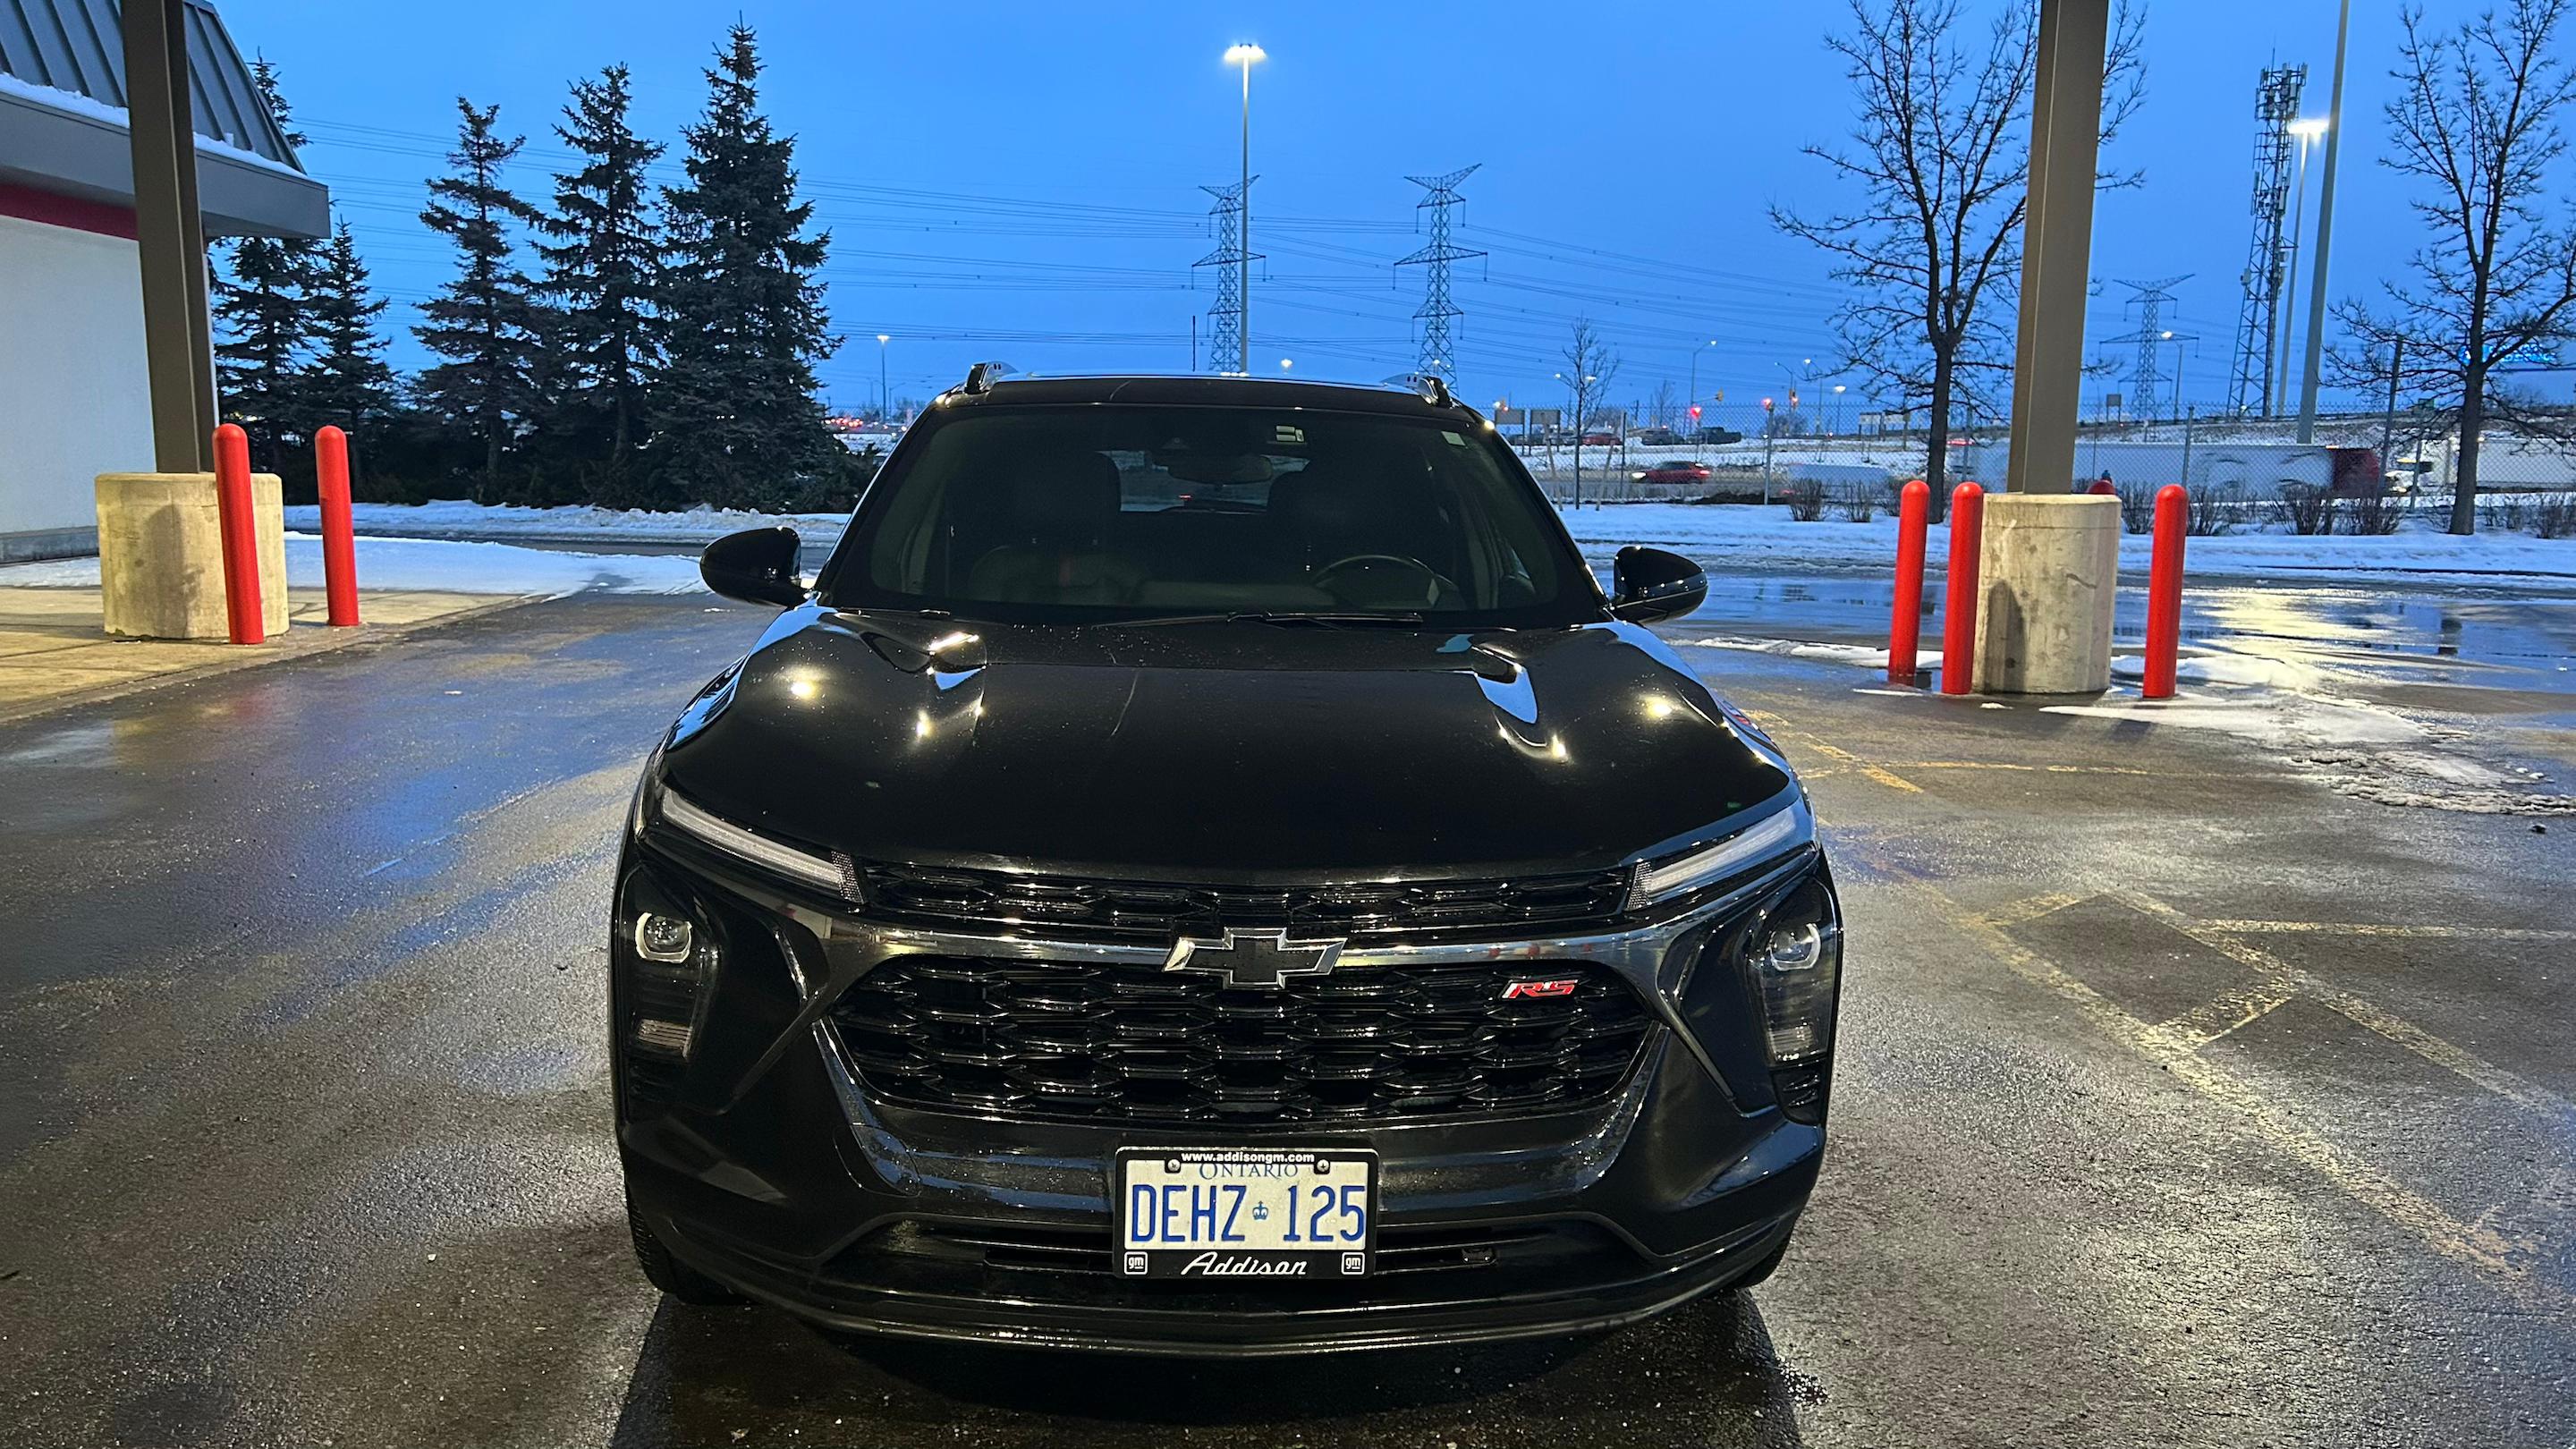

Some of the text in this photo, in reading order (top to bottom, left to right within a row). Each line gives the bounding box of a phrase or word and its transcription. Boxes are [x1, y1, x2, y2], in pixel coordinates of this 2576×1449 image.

[1501, 979, 1578, 999] RS
[1181, 1152, 1315, 1164] www.addisongm.com
[1199, 1163, 1299, 1180] ONTARIO
[1131, 1184, 1366, 1242] DEHZ 125
[1180, 1251, 1308, 1275] Addison
